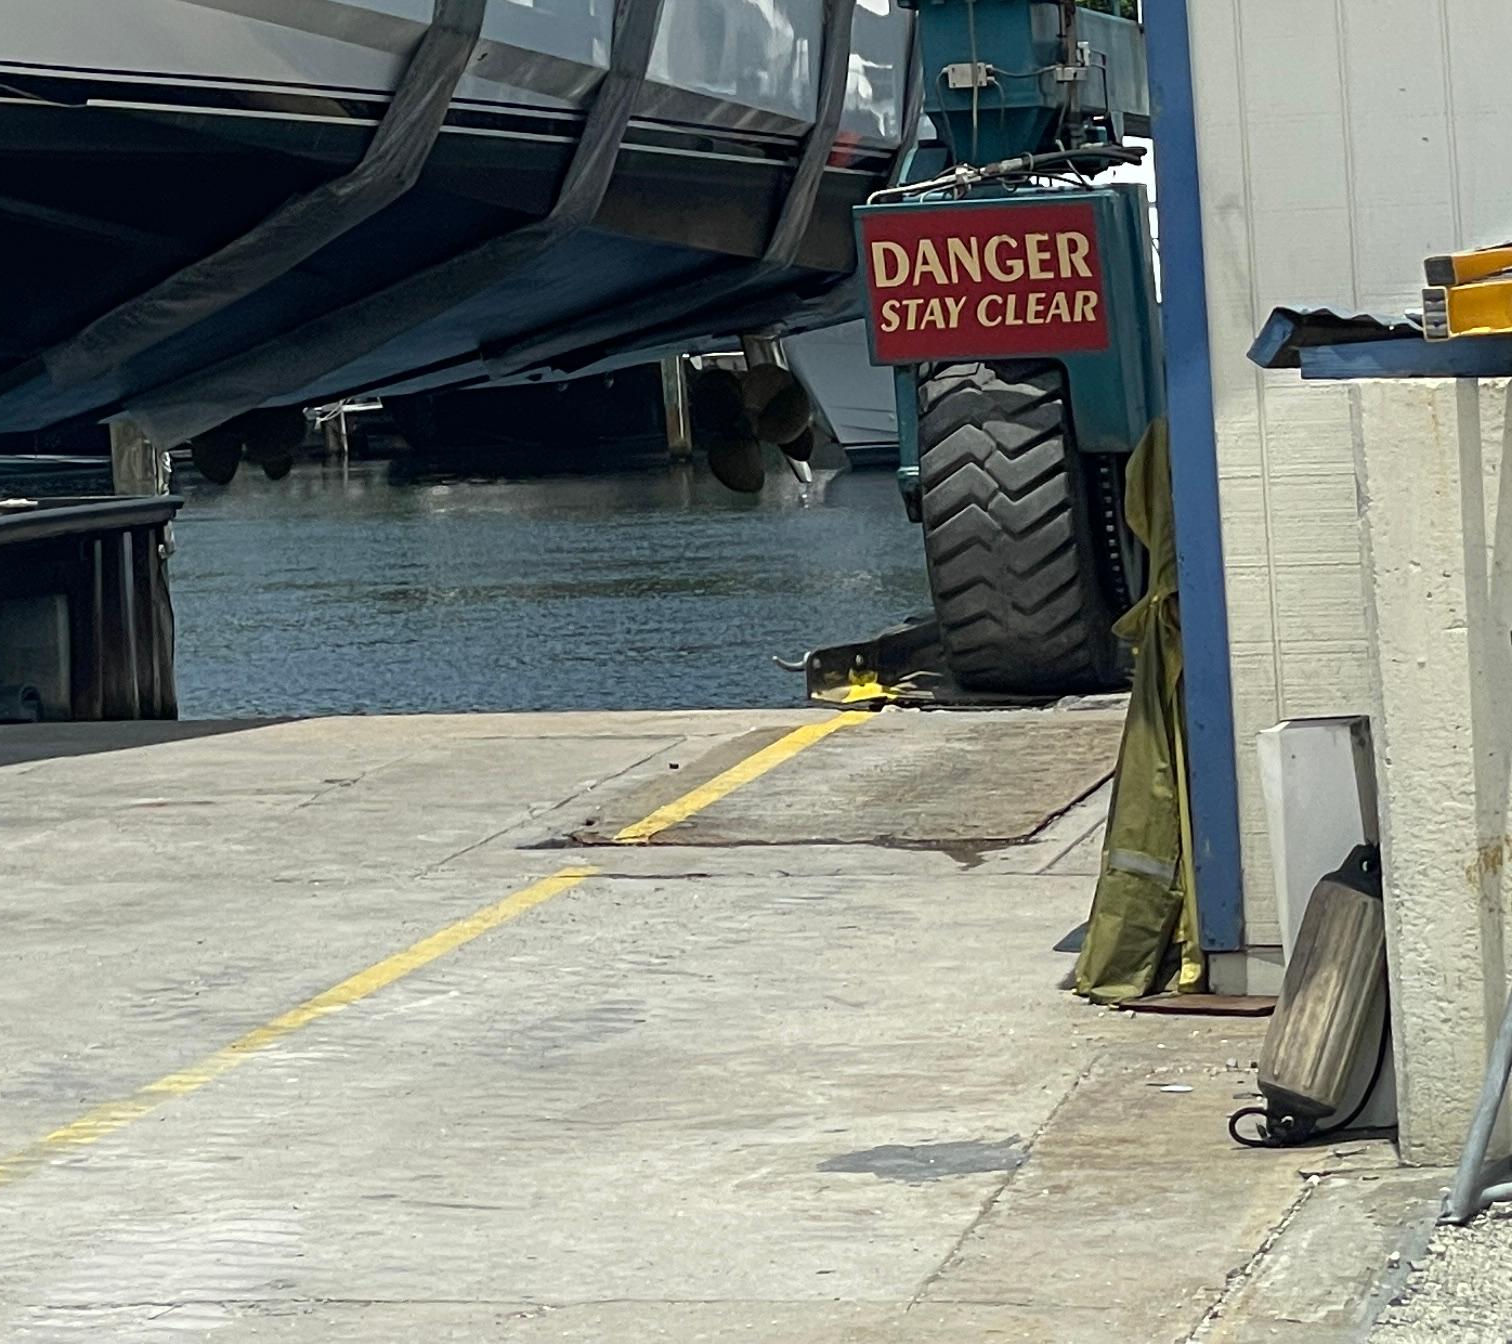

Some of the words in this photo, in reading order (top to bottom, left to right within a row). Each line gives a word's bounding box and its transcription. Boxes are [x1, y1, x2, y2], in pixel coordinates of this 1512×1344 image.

[870, 230, 1093, 289] DANGER
[880, 295, 967, 333] STAY
[976, 289, 1099, 328] CLEAR
